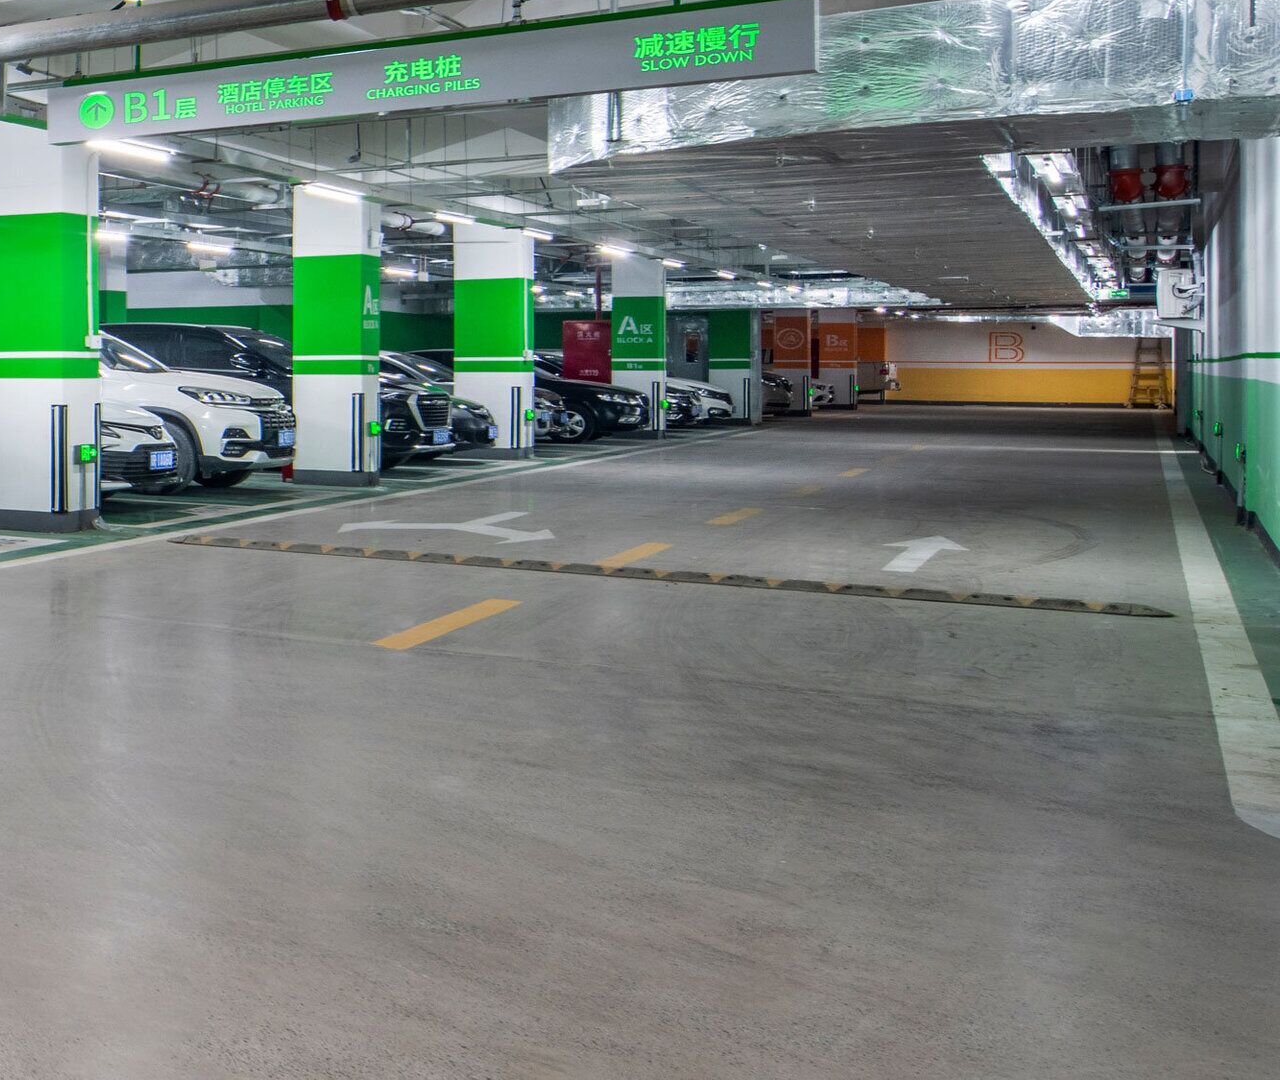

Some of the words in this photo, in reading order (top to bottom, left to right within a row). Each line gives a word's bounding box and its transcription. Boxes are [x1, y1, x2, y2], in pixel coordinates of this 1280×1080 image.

[634, 23, 760, 59] 减速慢行
[383, 54, 462, 84] 充电桩
[641, 56, 690, 72] SLOW
[694, 50, 753, 66] DOWN
[217, 72, 333, 104] 酒店停车区
[366, 82, 441, 100] CHARGING
[444, 78, 481, 92] PILES
[124, 88, 197, 124] B1层
[225, 102, 266, 114] HOTEL
[268, 95, 324, 110] PARKING
[988, 331, 1024, 363] B
